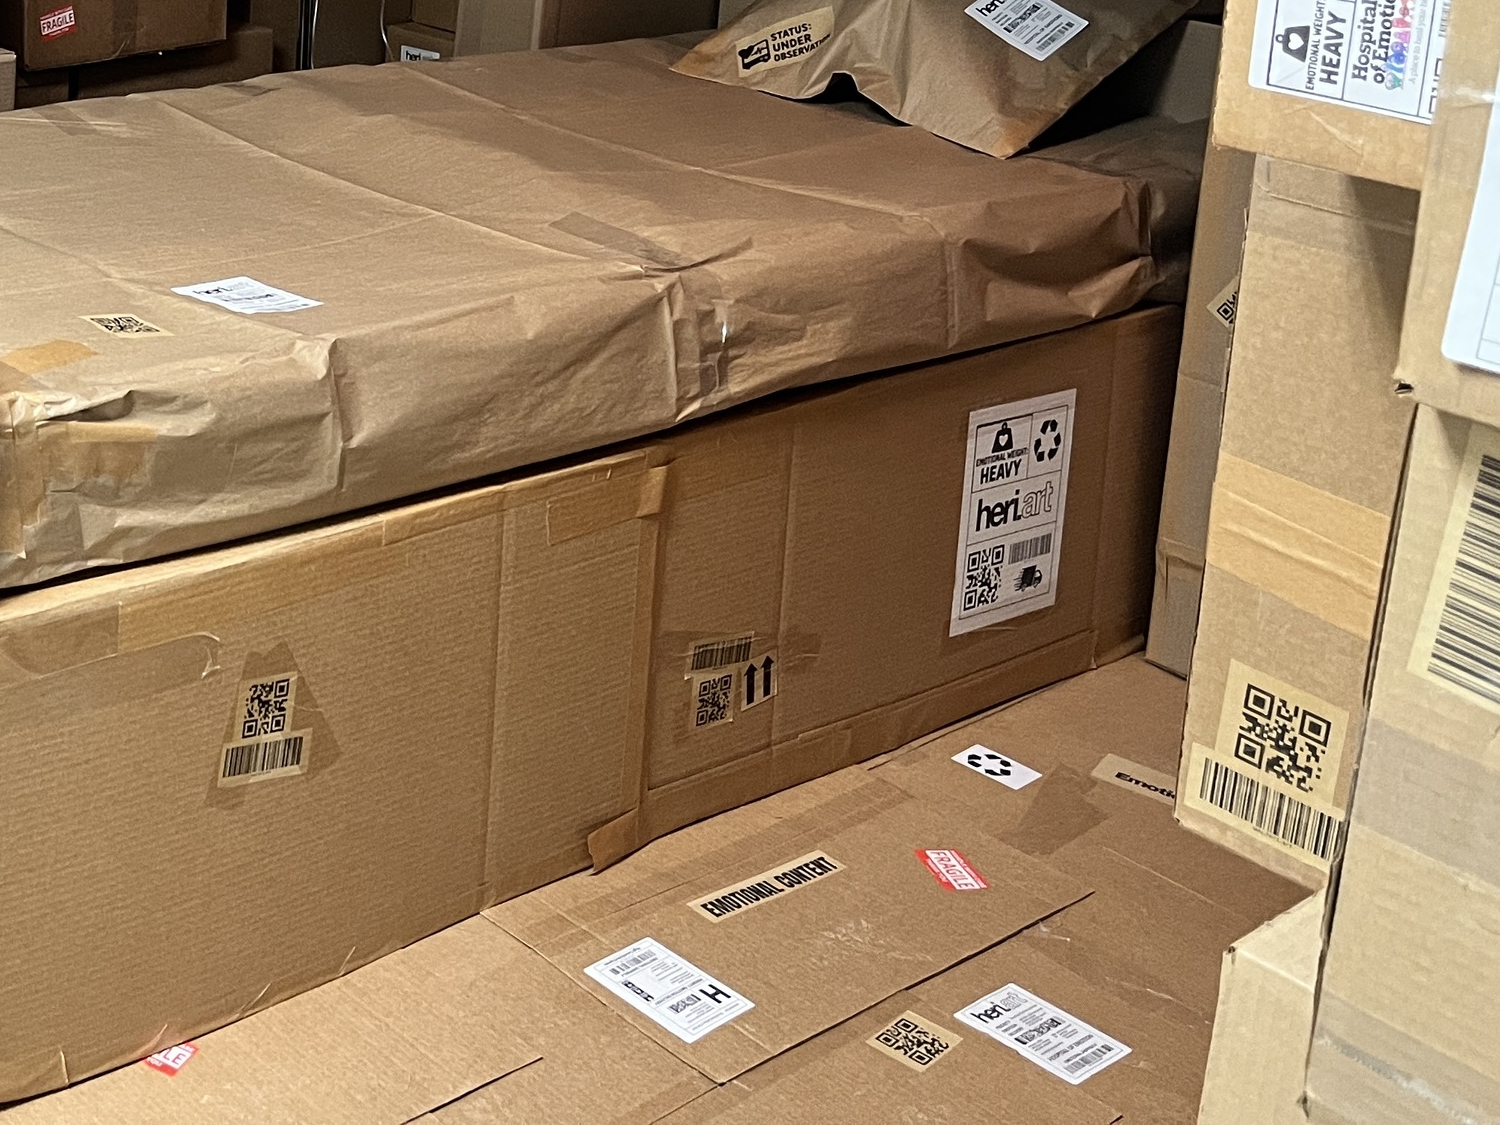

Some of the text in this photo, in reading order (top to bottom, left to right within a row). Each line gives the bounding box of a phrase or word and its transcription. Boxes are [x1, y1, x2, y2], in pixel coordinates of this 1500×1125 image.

[42, 9, 74, 35] FRAGILE
[770, 23, 812, 41] STATUS:
[772, 34, 812, 52] UNDER
[1319, 10, 1347, 85] HEAVY
[1351, 0, 1378, 82] Hospital
[1305, 36, 1320, 91] EMOTIONAL
[1372, 61, 1390, 84] of
[975, 453, 1006, 467] EMOTIONAL
[980, 459, 1022, 485] HEAVY
[926, 850, 975, 889] FRAGILE
[700, 856, 839, 917] EMOTIONAL CONTENT
[699, 982, 732, 1004] H
